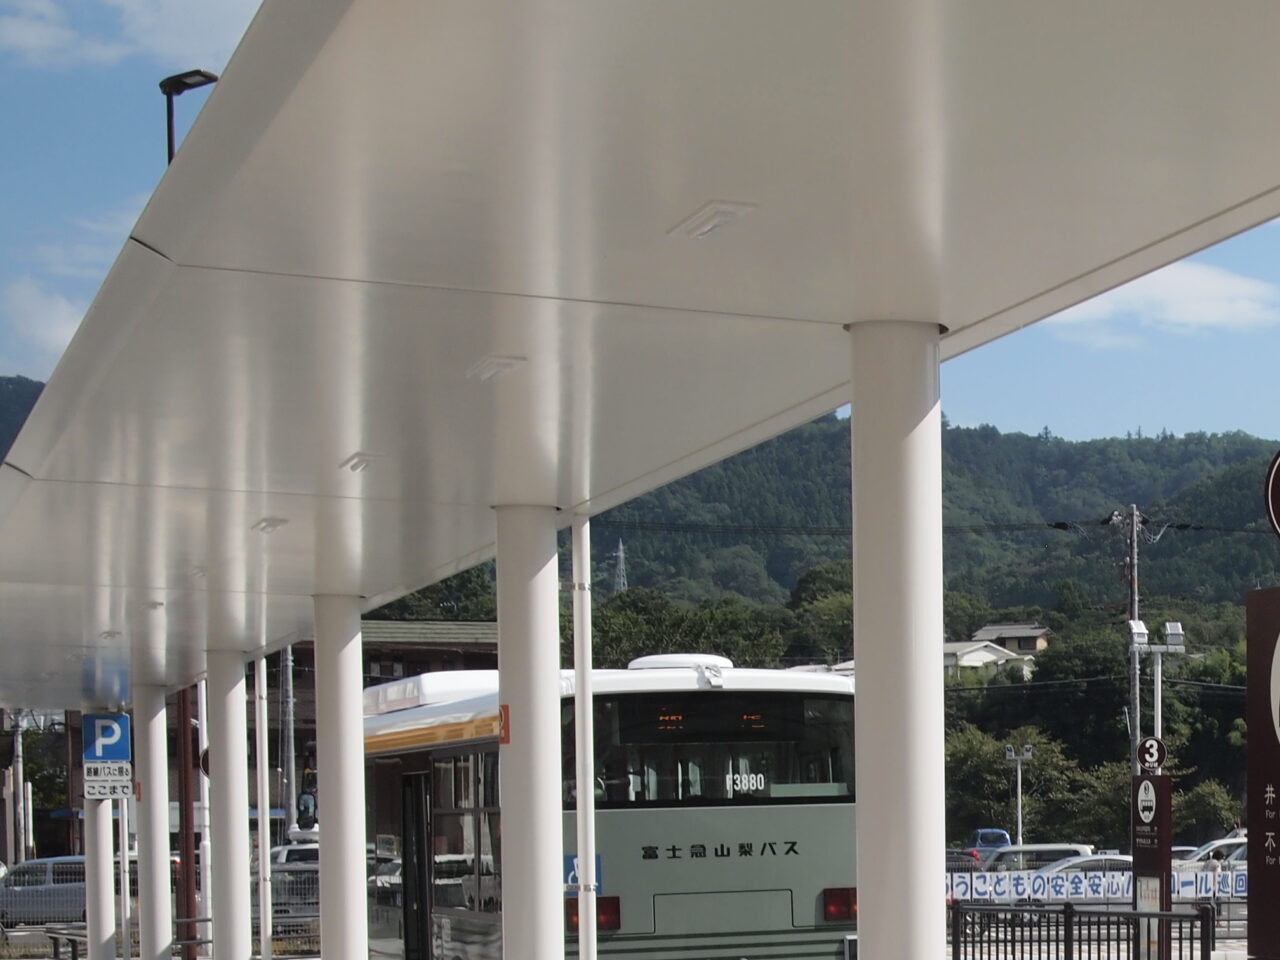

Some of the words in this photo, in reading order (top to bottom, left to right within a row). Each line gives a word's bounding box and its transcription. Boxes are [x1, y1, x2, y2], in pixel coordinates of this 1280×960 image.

[95, 719, 122, 757] P
[1144, 740, 1158, 763] 3
[87, 785, 130, 796] ここまで
[642, 841, 799, 860] 富士急山梨バス
